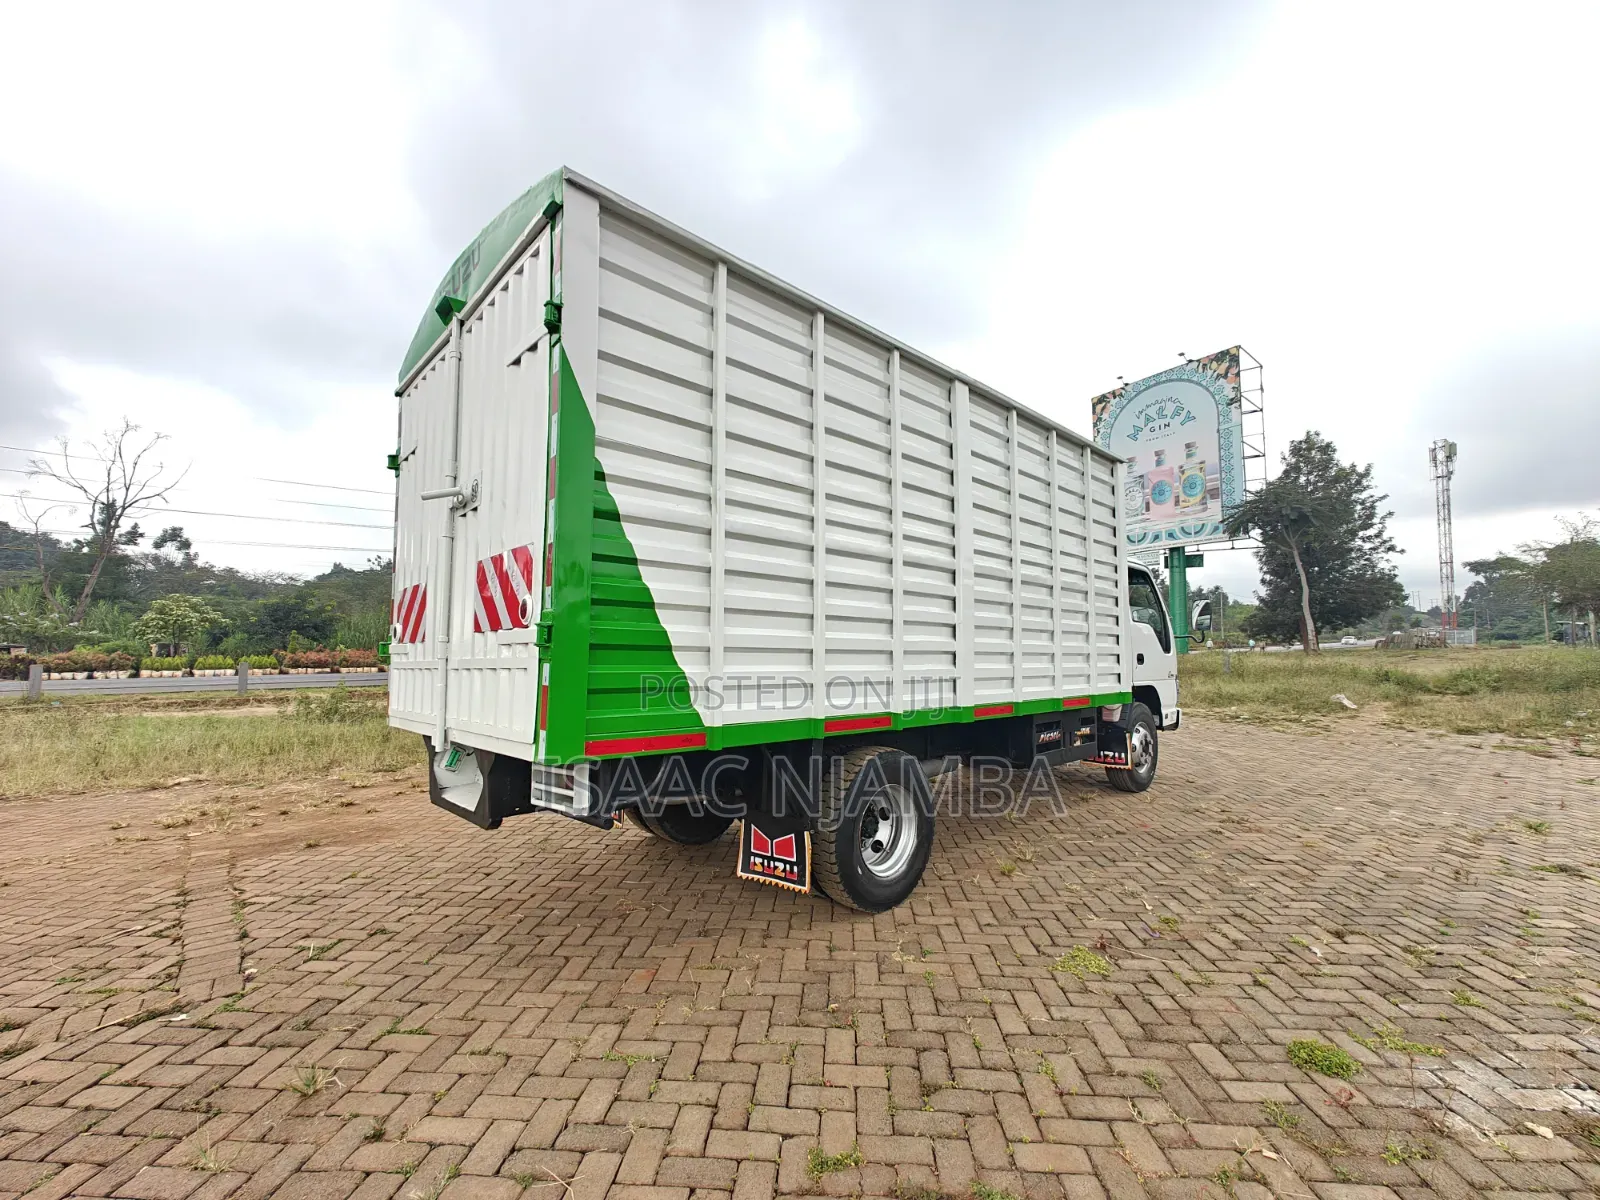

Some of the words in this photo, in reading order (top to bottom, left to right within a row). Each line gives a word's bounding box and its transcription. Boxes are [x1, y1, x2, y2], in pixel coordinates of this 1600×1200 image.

[1126, 405, 1197, 442] MALFY
[1149, 421, 1171, 433] GIN
[749, 855, 798, 880] ISUZU
